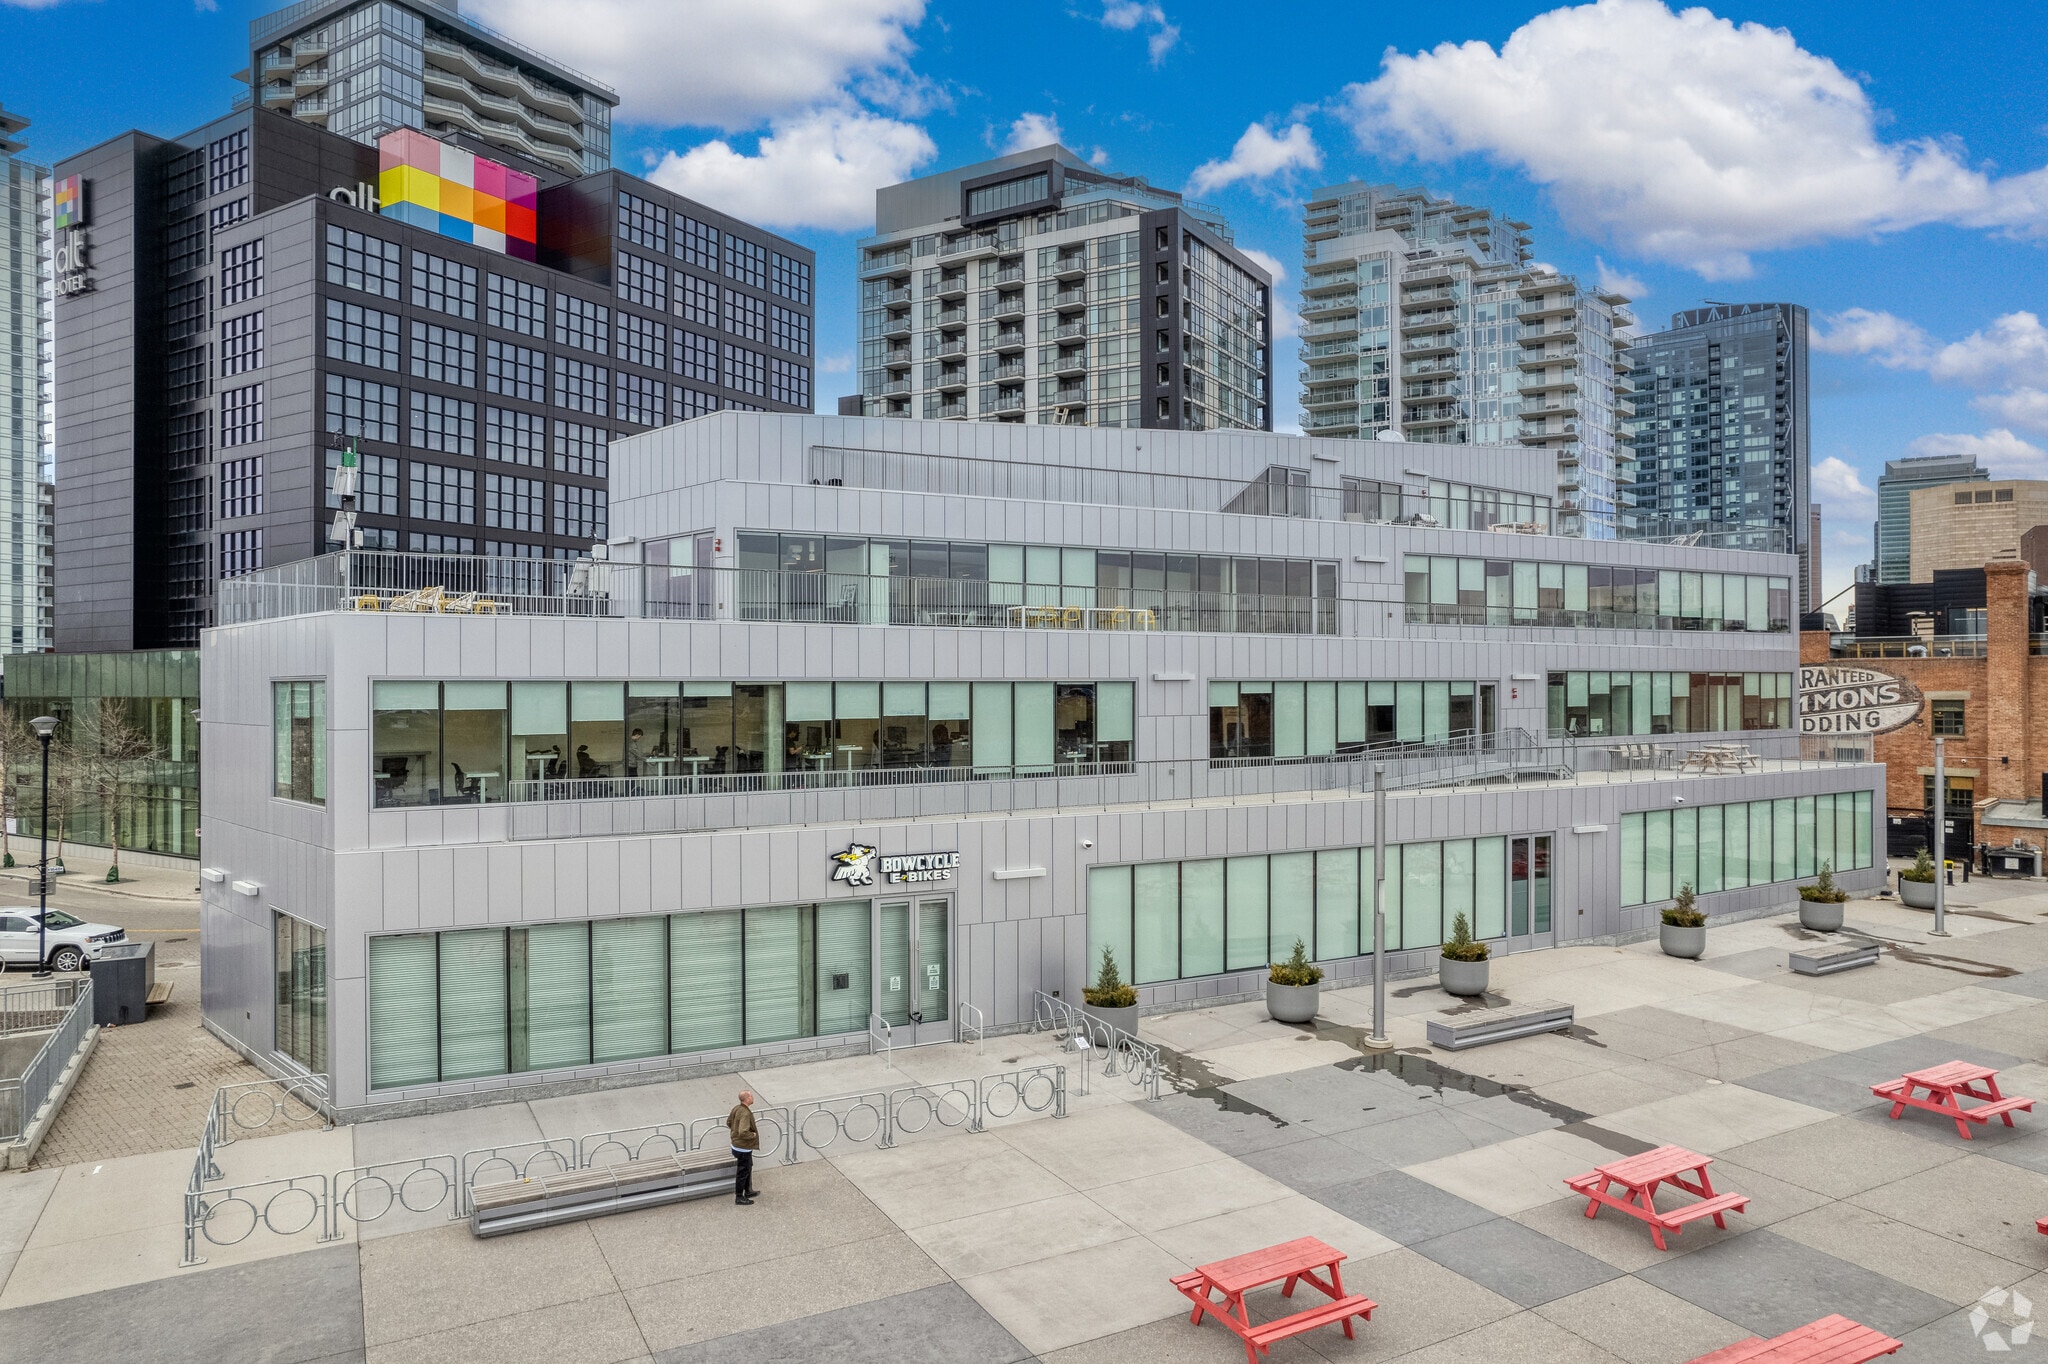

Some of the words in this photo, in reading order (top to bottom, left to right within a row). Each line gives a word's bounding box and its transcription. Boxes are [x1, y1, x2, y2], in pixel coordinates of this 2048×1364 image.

[330, 182, 381, 212] alt
[56, 230, 84, 273] alt
[54, 275, 86, 296] HOTEL
[1800, 669, 1875, 688] RANTEED
[1803, 711, 1880, 732] DDING
[881, 852, 960, 872] BOWCYCLE
